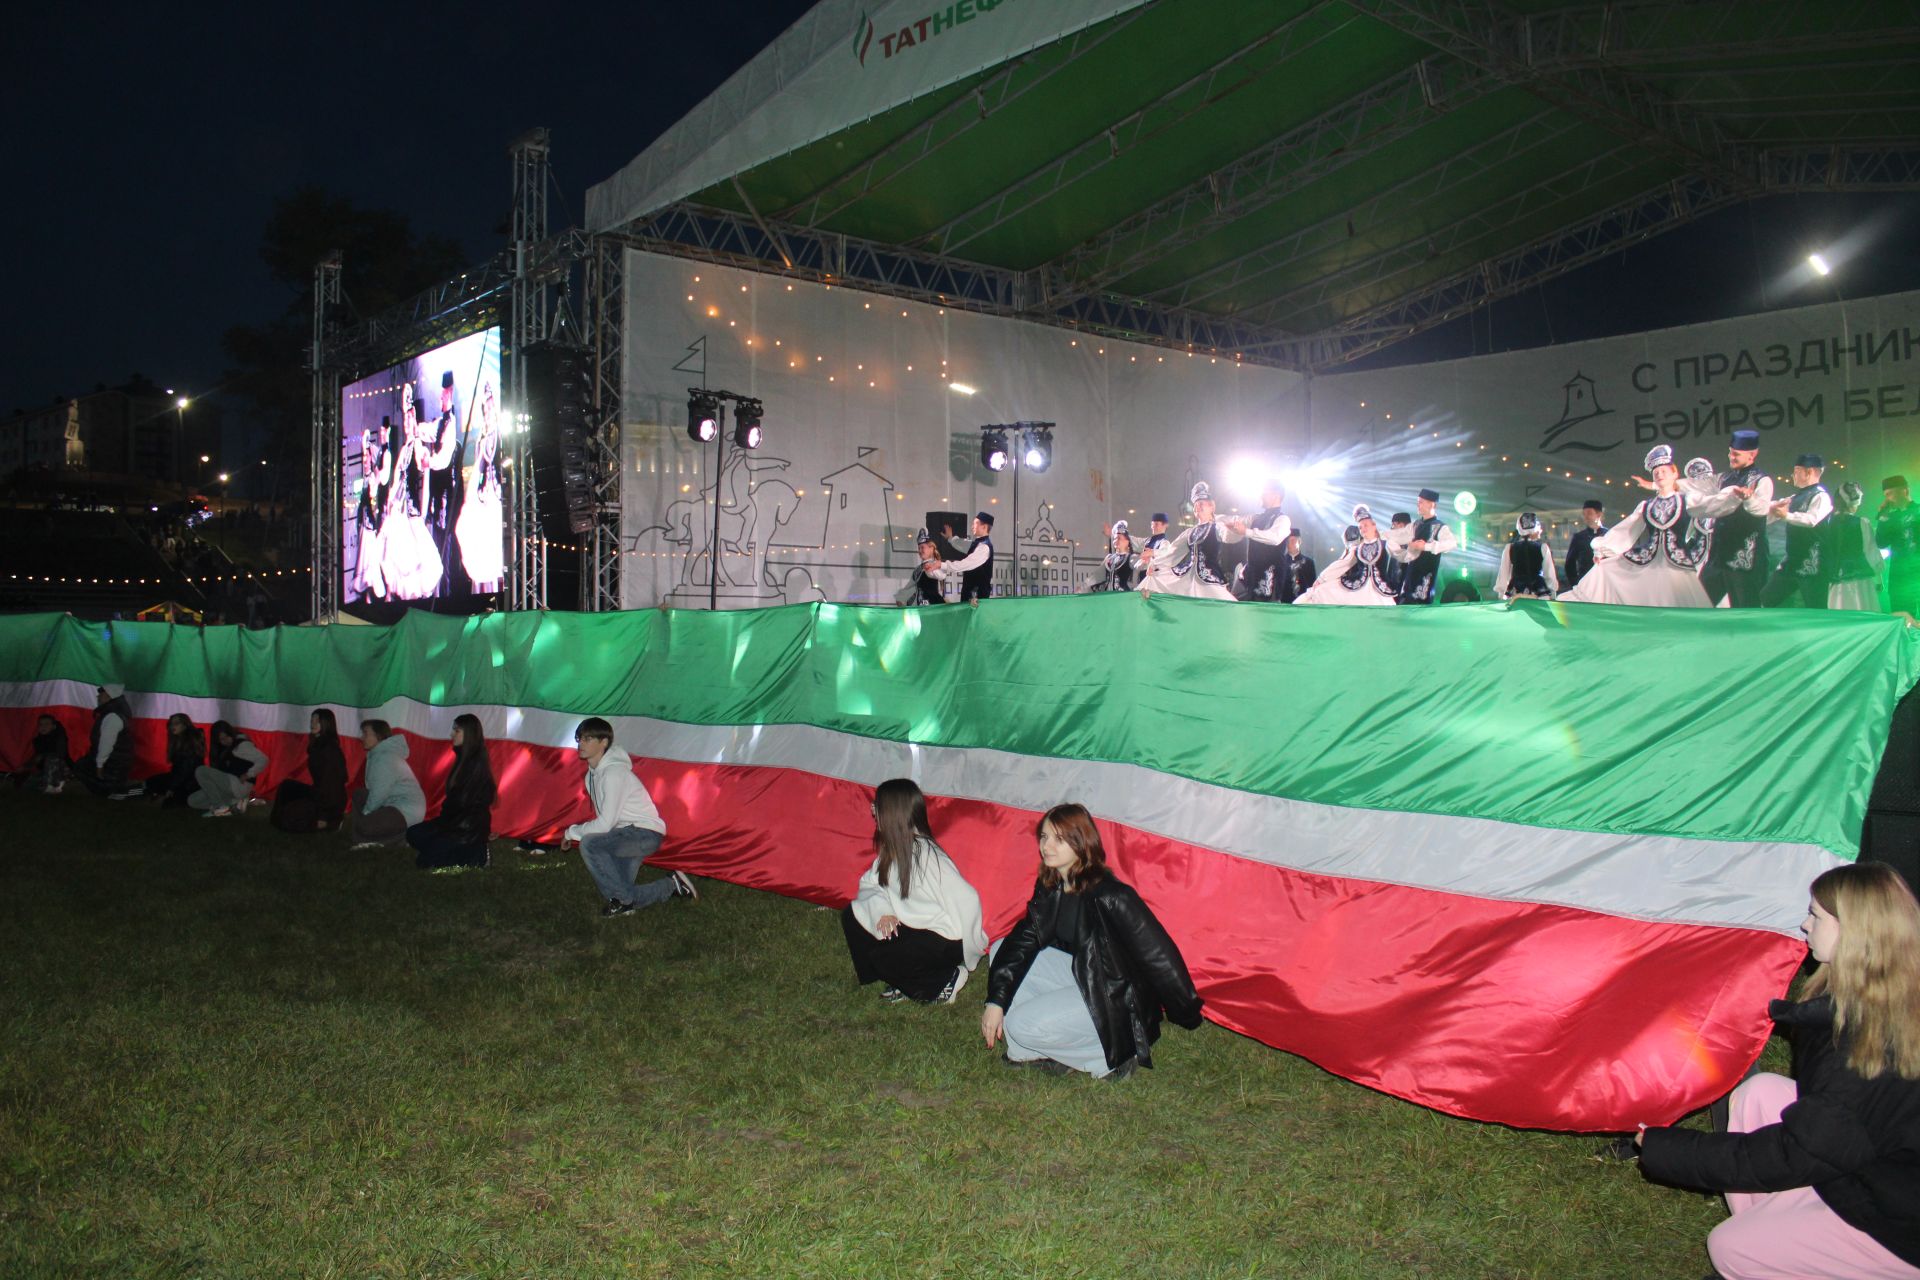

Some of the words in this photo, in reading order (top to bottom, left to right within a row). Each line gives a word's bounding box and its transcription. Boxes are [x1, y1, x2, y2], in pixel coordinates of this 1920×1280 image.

[879, 0, 1016, 58] ТАТНЕФ
[1631, 362, 1658, 393] С
[1633, 393, 1824, 444] БӘЙРӘМ
